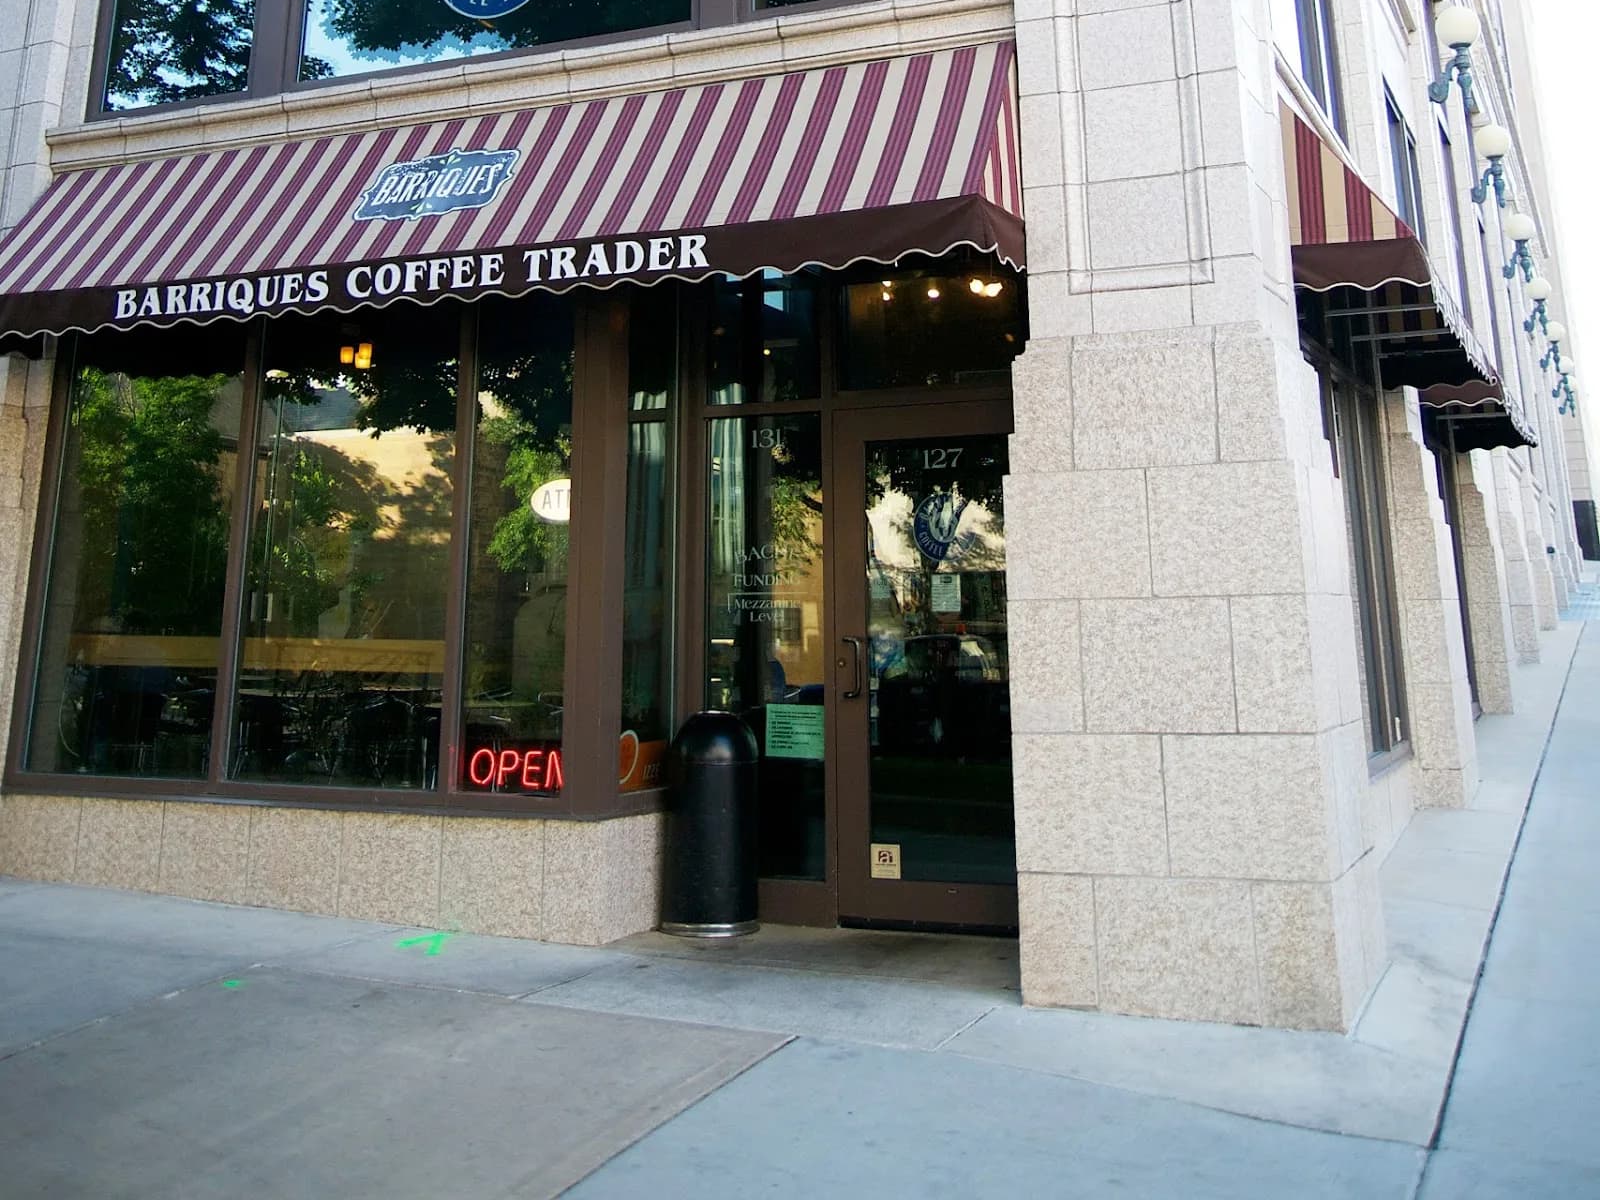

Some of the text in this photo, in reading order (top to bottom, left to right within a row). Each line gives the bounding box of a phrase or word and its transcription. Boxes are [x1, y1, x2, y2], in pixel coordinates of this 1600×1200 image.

[371, 162, 503, 206] BARRIQUES
[114, 234, 710, 319] BARRIQUES COFFEE TRADER
[752, 428, 781, 449] 131
[922, 447, 964, 469] 127
[542, 488, 571, 510] AT
[734, 573, 800, 588] FUNDING
